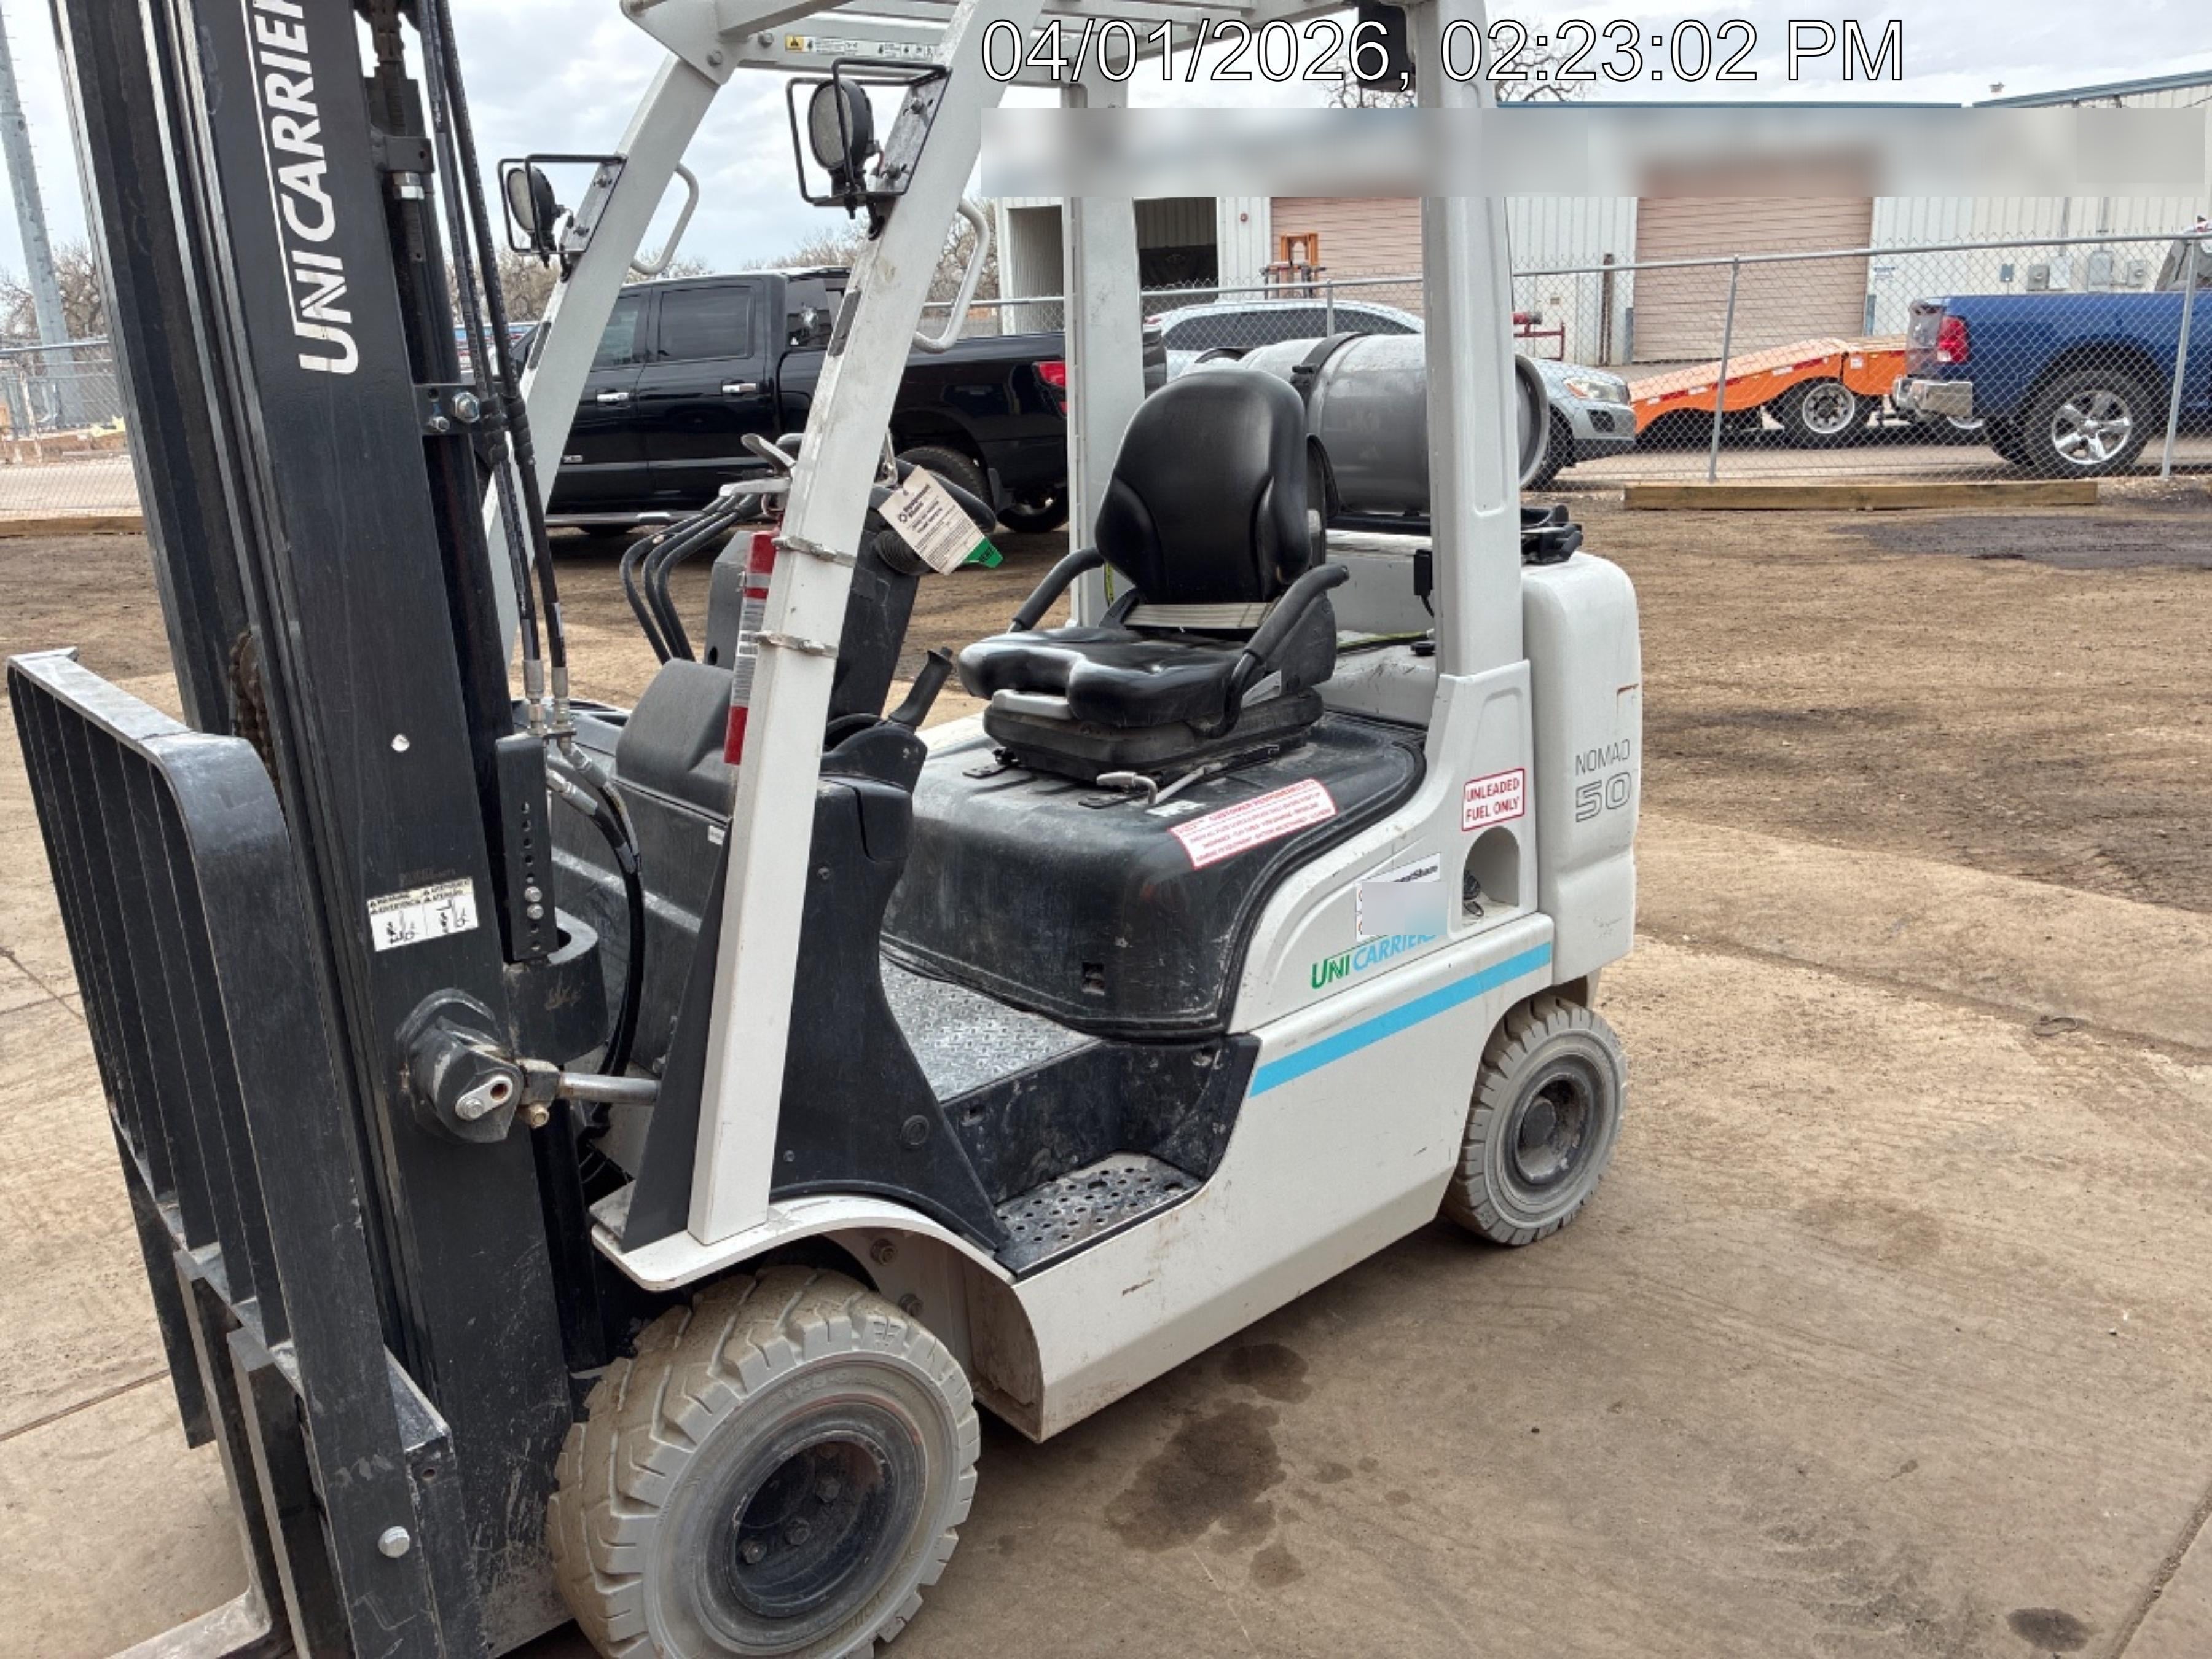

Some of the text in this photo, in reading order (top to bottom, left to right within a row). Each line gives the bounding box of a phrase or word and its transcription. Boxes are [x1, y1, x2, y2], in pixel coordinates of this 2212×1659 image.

[1575, 739, 1630, 777] NOMAD
[1466, 777, 1520, 802] UNLEADED
[1575, 772, 1632, 823] 50
[1465, 796, 1520, 822] FUEL ONLY
